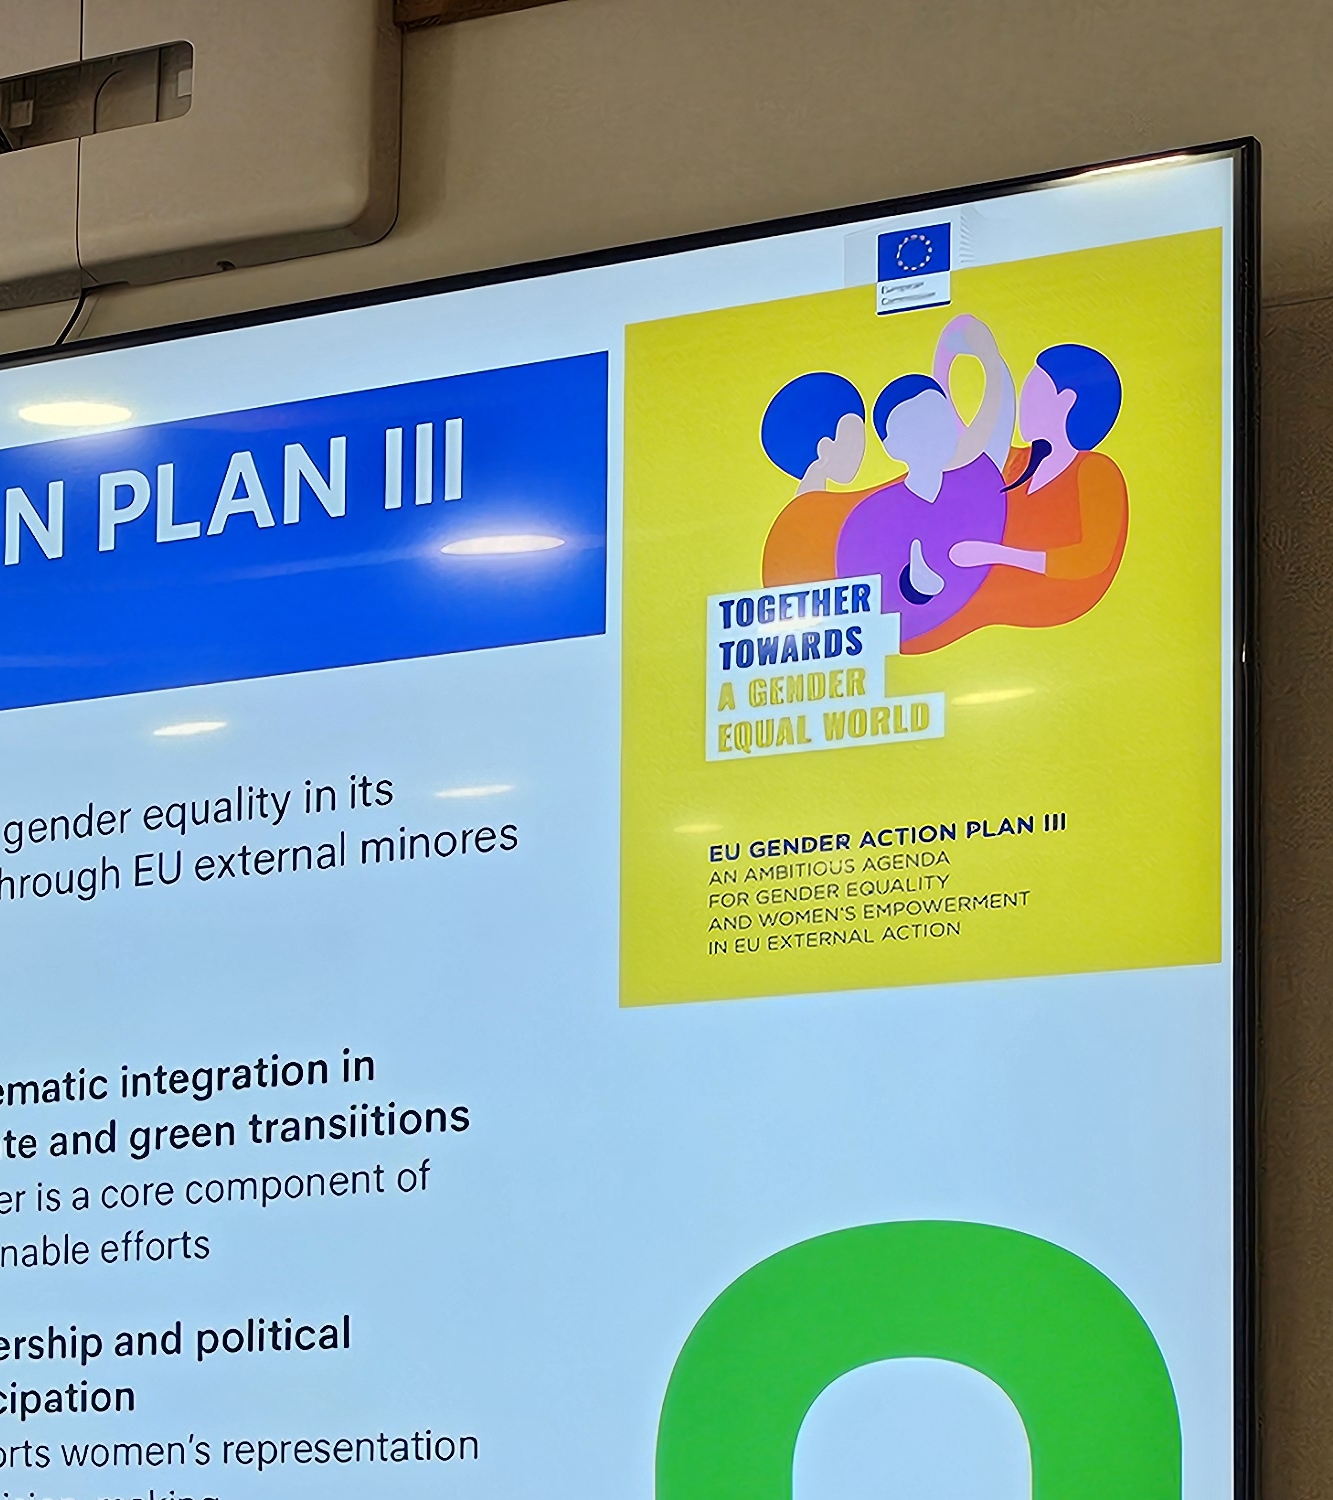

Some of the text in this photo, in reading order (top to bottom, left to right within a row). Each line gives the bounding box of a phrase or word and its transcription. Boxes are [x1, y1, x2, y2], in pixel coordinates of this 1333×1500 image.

[98, 435, 347, 552] PLAN
[384, 417, 463, 510] III
[718, 583, 871, 630] TOGETHER
[718, 625, 863, 671] TOWARDS
[717, 667, 866, 712] A GENDER
[717, 701, 931, 754] EQUAL WORLD
[3, 801, 132, 855] gender
[143, 785, 292, 836] equality
[304, 779, 336, 814] in
[349, 774, 394, 810] its
[709, 812, 1066, 863] EU GENDER ACTION PLAN III
[134, 849, 182, 887] EU
[194, 830, 345, 882] external
[361, 824, 518, 865] minores
[708, 850, 951, 887] AN AMBITIOUS AGENDA
[707, 914, 753, 933] AND
[863, 890, 1031, 920] EMPOWERMENT
[708, 873, 950, 909] FOR GENDER EQUALITY
[708, 921, 961, 956] IN EU EXTERNAL ACTION
[121, 1053, 328, 1102] integration
[342, 1047, 375, 1083] in
[49, 1118, 116, 1158] and
[129, 1121, 235, 1161] green
[248, 1101, 470, 1144] transiitions
[37, 1181, 61, 1213] is
[71, 1186, 89, 1211] a
[101, 1181, 175, 1210] core
[185, 1164, 385, 1208] component
[397, 1157, 431, 1193] of
[100, 1229, 210, 1264] efforts
[114, 1320, 182, 1357] and
[197, 1314, 350, 1363] political
[223, 1429, 479, 1472] representation
